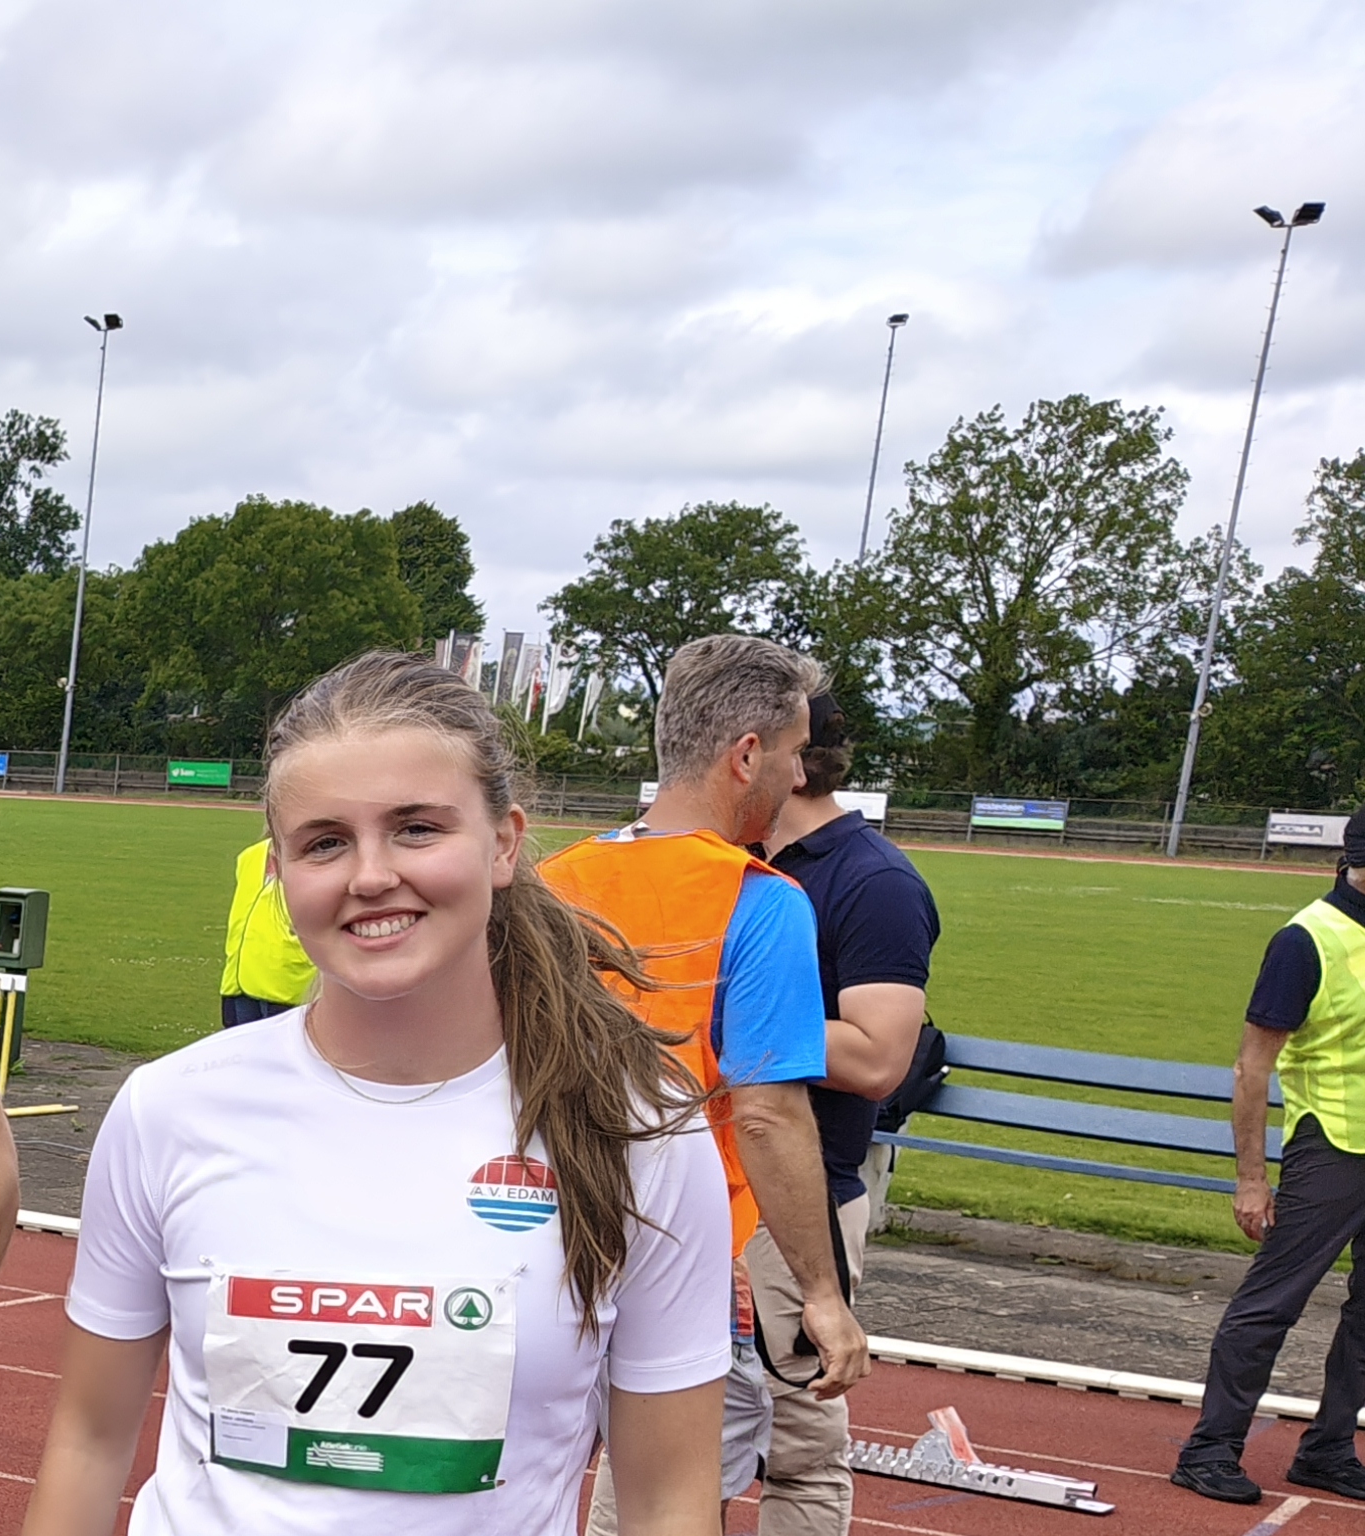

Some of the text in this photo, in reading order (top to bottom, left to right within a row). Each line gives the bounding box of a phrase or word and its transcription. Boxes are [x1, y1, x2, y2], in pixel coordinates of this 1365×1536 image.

[507, 1187, 555, 1203] EDAM
[270, 1285, 432, 1320] SPAR
[287, 1338, 415, 1419] 77
